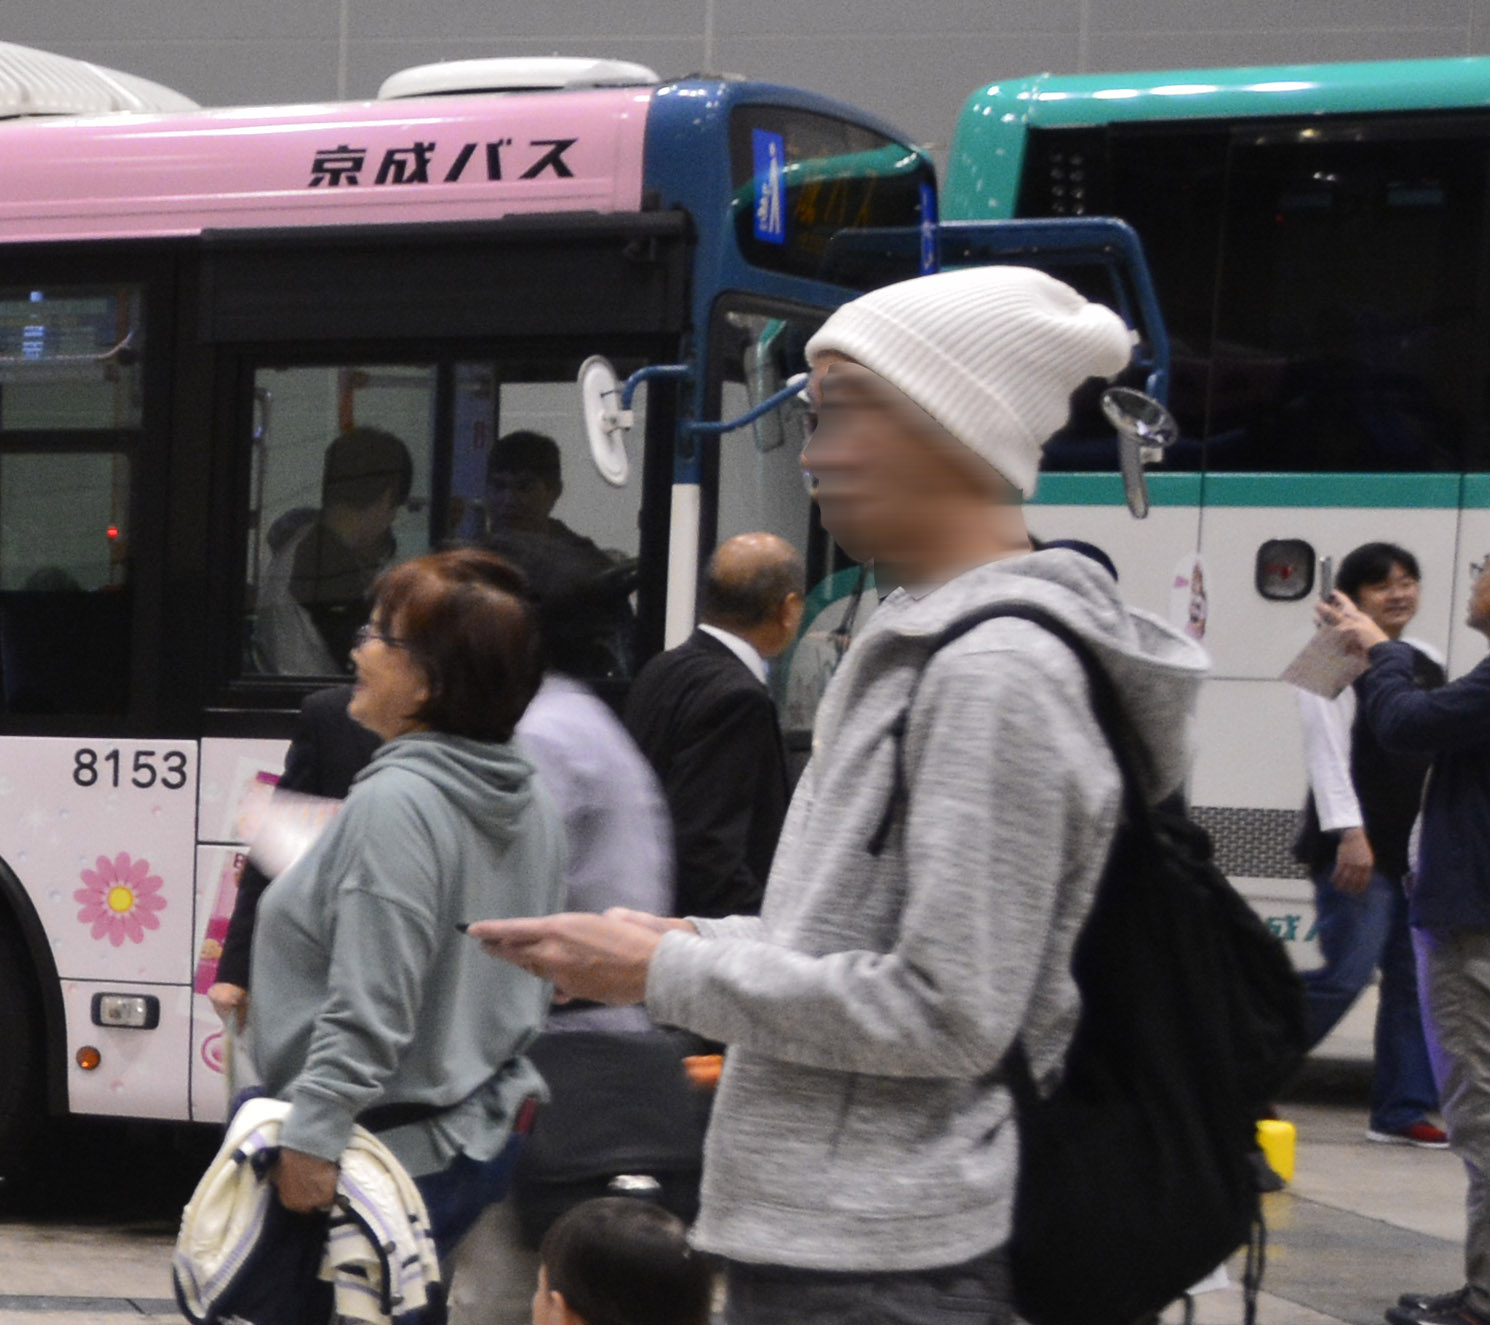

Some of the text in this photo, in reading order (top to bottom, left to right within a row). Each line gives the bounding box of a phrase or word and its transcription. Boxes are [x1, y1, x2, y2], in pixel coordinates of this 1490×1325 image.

[308, 138, 579, 188] 京成バス
[73, 748, 187, 789] 8153
